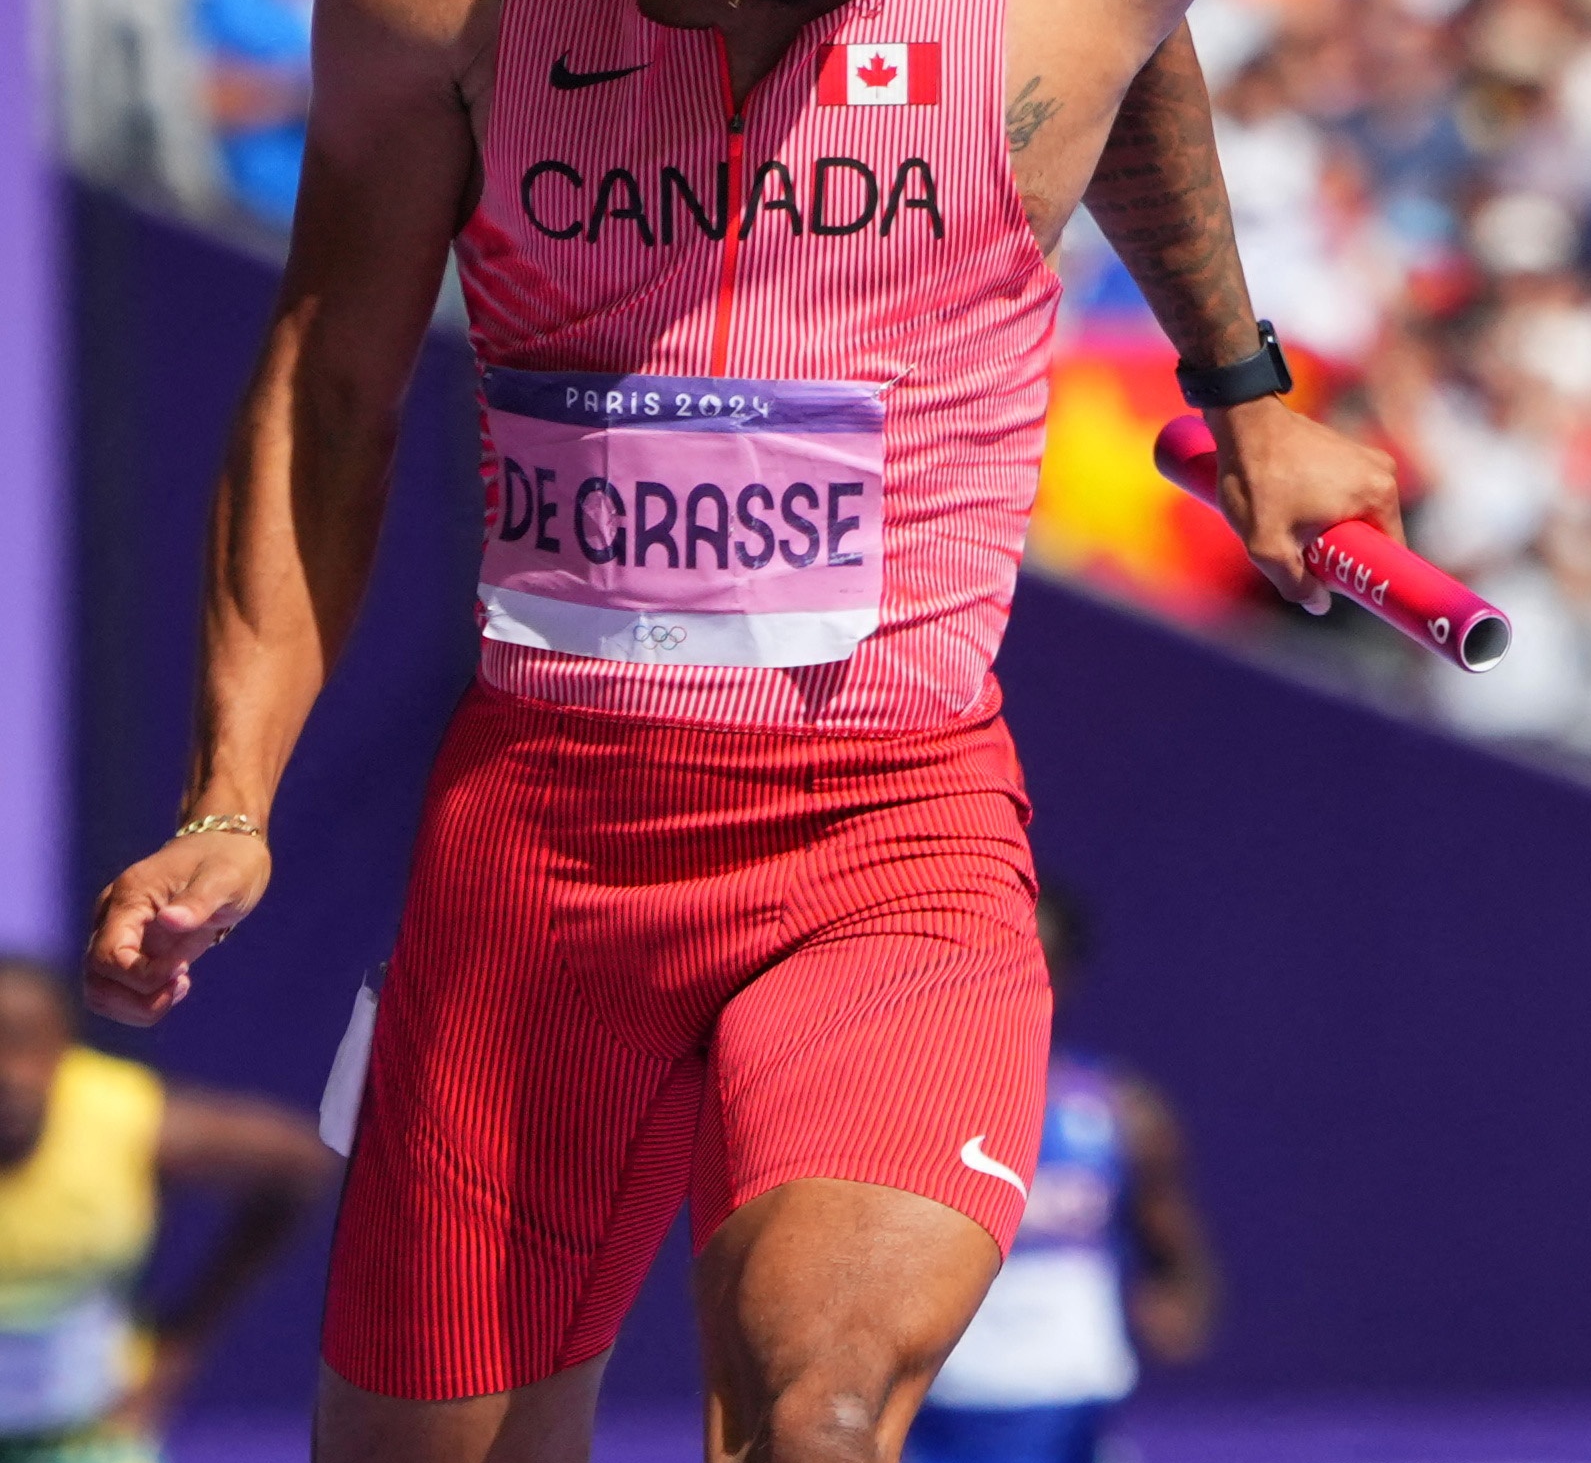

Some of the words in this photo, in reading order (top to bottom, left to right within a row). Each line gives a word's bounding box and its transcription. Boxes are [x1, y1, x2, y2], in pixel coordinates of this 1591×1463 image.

[522, 157, 945, 247] CANADA
[675, 393, 774, 419] 2024
[499, 455, 560, 554] DE
[574, 476, 864, 570] GRASSE
